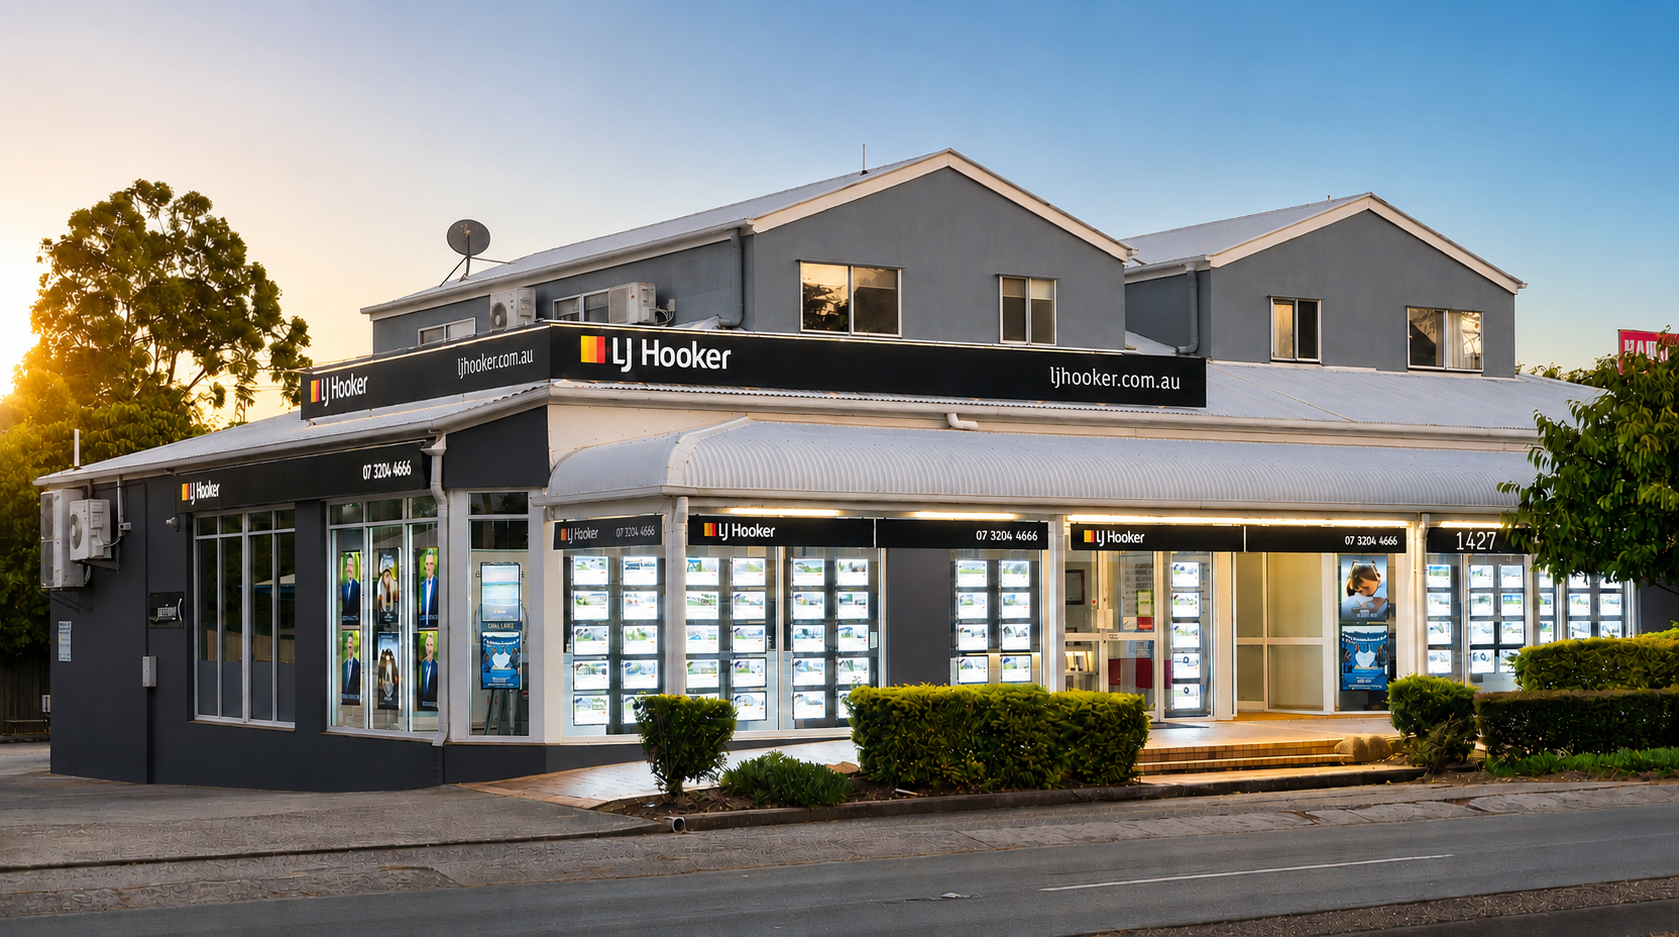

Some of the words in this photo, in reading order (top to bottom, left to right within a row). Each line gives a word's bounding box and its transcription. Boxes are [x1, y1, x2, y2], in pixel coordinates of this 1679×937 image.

[457, 347, 534, 379] ljhooker.com.au
[613, 337, 632, 372] LJ
[642, 338, 731, 369] Hooker
[1050, 366, 1180, 389] ljhooker.com.au
[321, 377, 329, 407] LJ
[331, 373, 368, 400] Hooker
[363, 464, 372, 481] 07
[374, 462, 392, 479] 3204
[393, 459, 412, 477] 4666
[190, 482, 195, 506] LJ
[196, 480, 220, 500] Hooker
[574, 527, 599, 540] Hooker
[719, 523, 728, 541] LJ
[732, 523, 775, 537] Hooker
[976, 530, 987, 541] 07
[990, 530, 1013, 541] 3204
[1015, 530, 1038, 541] 4666
[1096, 529, 1104, 546] LJ
[1107, 530, 1145, 544] Hooker
[1344, 535, 1355, 546] 07
[1357, 535, 1377, 546] 3204
[1379, 535, 1399, 546] 4666
[1456, 531, 1497, 550] 1427
